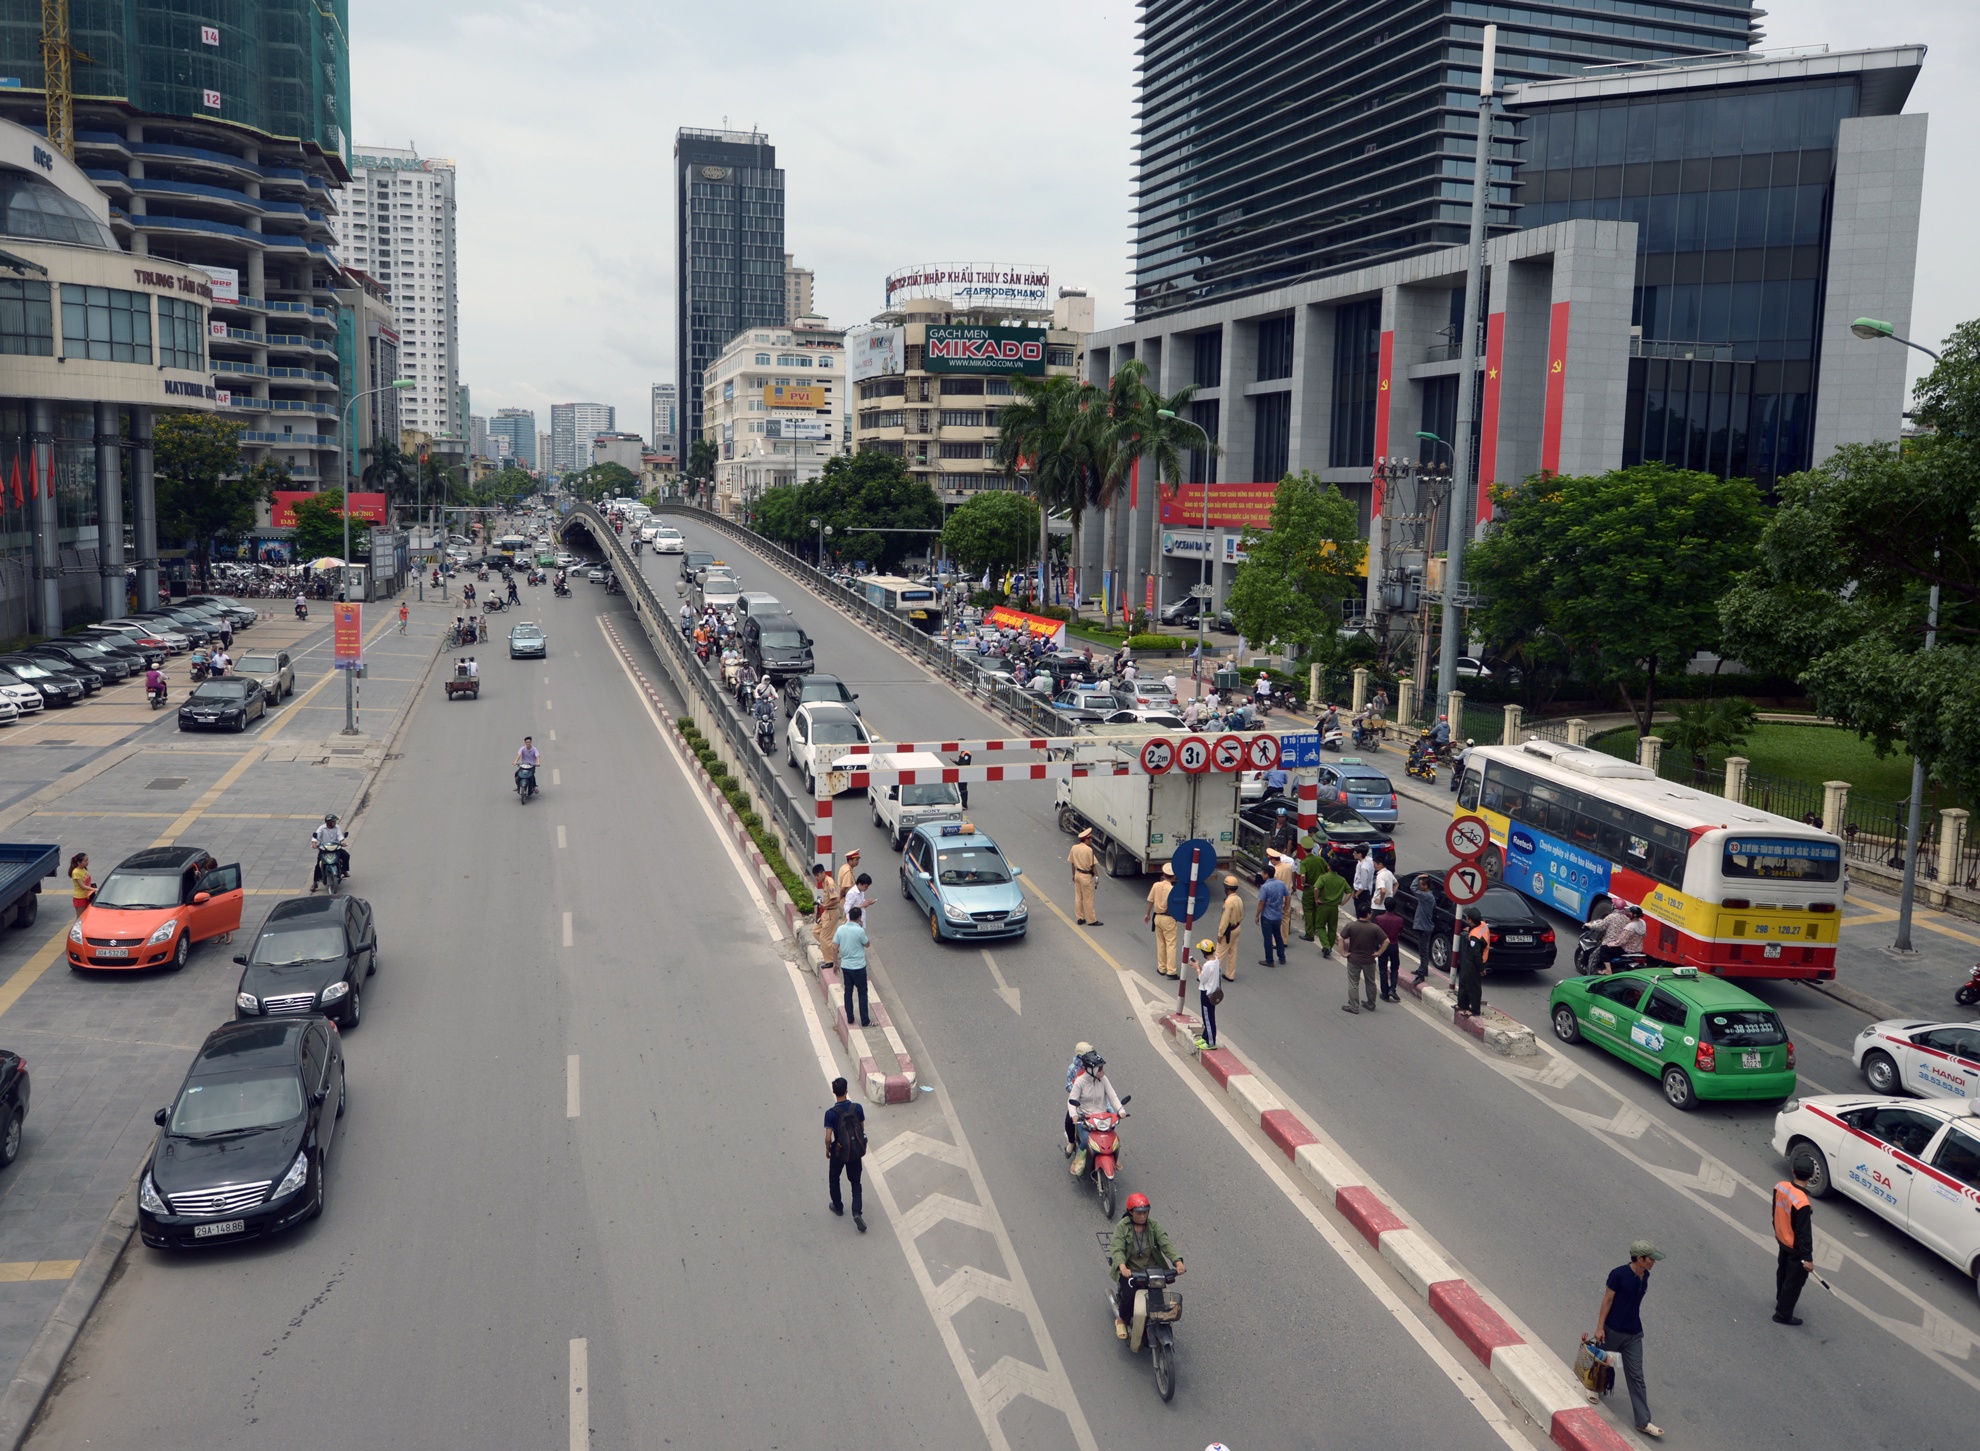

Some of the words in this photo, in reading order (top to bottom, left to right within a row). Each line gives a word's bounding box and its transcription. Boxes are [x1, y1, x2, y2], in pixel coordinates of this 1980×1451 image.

[203, 30, 218, 43] 14
[205, 93, 220, 106] 12
[134, 269, 174, 289] TRUNG
[923, 269, 946, 286] NHẬP
[948, 266, 973, 283] KHẨU
[1002, 267, 1022, 285] SẢN
[213, 324, 226, 334] 6F
[929, 329, 961, 340] GẠCH
[963, 329, 989, 339] MEN
[929, 339, 1042, 361] MIKADO
[164, 379, 205, 398] NATIONAL
[217, 394, 229, 403] 4F
[790, 392, 810, 401] PVI
[280, 517, 296, 526] ĐẠI
[1174, 539, 1195, 550] OCEAN
[1195, 541, 1212, 552] BAK
[1283, 736, 1288, 744] Ô
[1288, 736, 1297, 744] TÔ
[1307, 736, 1318, 744] MÁY
[1147, 750, 1169, 764] 2.2m
[1512, 835, 1533, 851] Reetech
[1730, 843, 1739, 852] 33
[1755, 924, 1769, 934] 29B
[1778, 925, 1801, 935] 120.27
[1734, 1024, 1745, 1033] 38
[1745, 1023, 1760, 1033] 333
[1759, 1022, 1774, 1032] 333
[1932, 1067, 1966, 1087] HANOI
[1918, 1071, 1966, 1097] 38.53.53.53
[1872, 1170, 1892, 1190] 3A
[1849, 1170, 1898, 1206] 38.57.57.57
